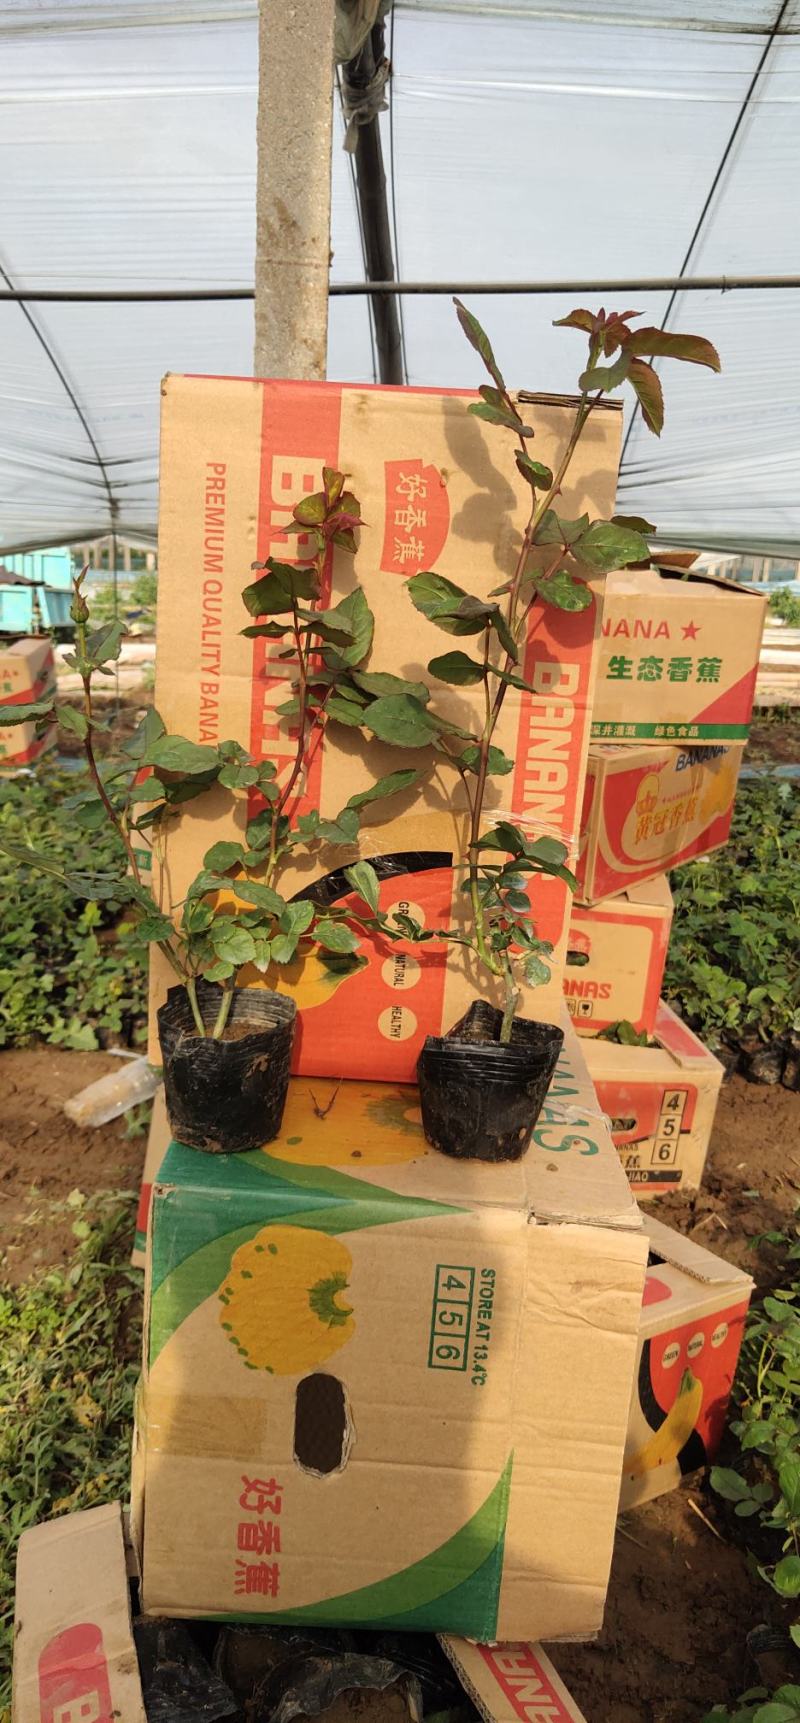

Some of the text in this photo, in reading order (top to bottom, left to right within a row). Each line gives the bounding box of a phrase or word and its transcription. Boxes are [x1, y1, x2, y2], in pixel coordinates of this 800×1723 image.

[393, 472, 428, 564] 好香蕉
[198, 462, 227, 746] PREMIUM QUALITY BANA
[606, 655, 723, 683] 生态香蕉
[519, 660, 580, 882] BANAN
[396, 901, 410, 936] GRN
[393, 953, 407, 987] NATURAL
[390, 1005, 403, 1038] HEALTHY
[667, 1093, 680, 1111] 4
[663, 1118, 675, 1136] 5
[658, 1143, 671, 1160] 6
[476, 1268, 496, 1320] STORE
[435, 1275, 467, 1360] 4 5 6
[475, 1321, 491, 1341] AT
[234, 1475, 284, 1598] 好香蕉
